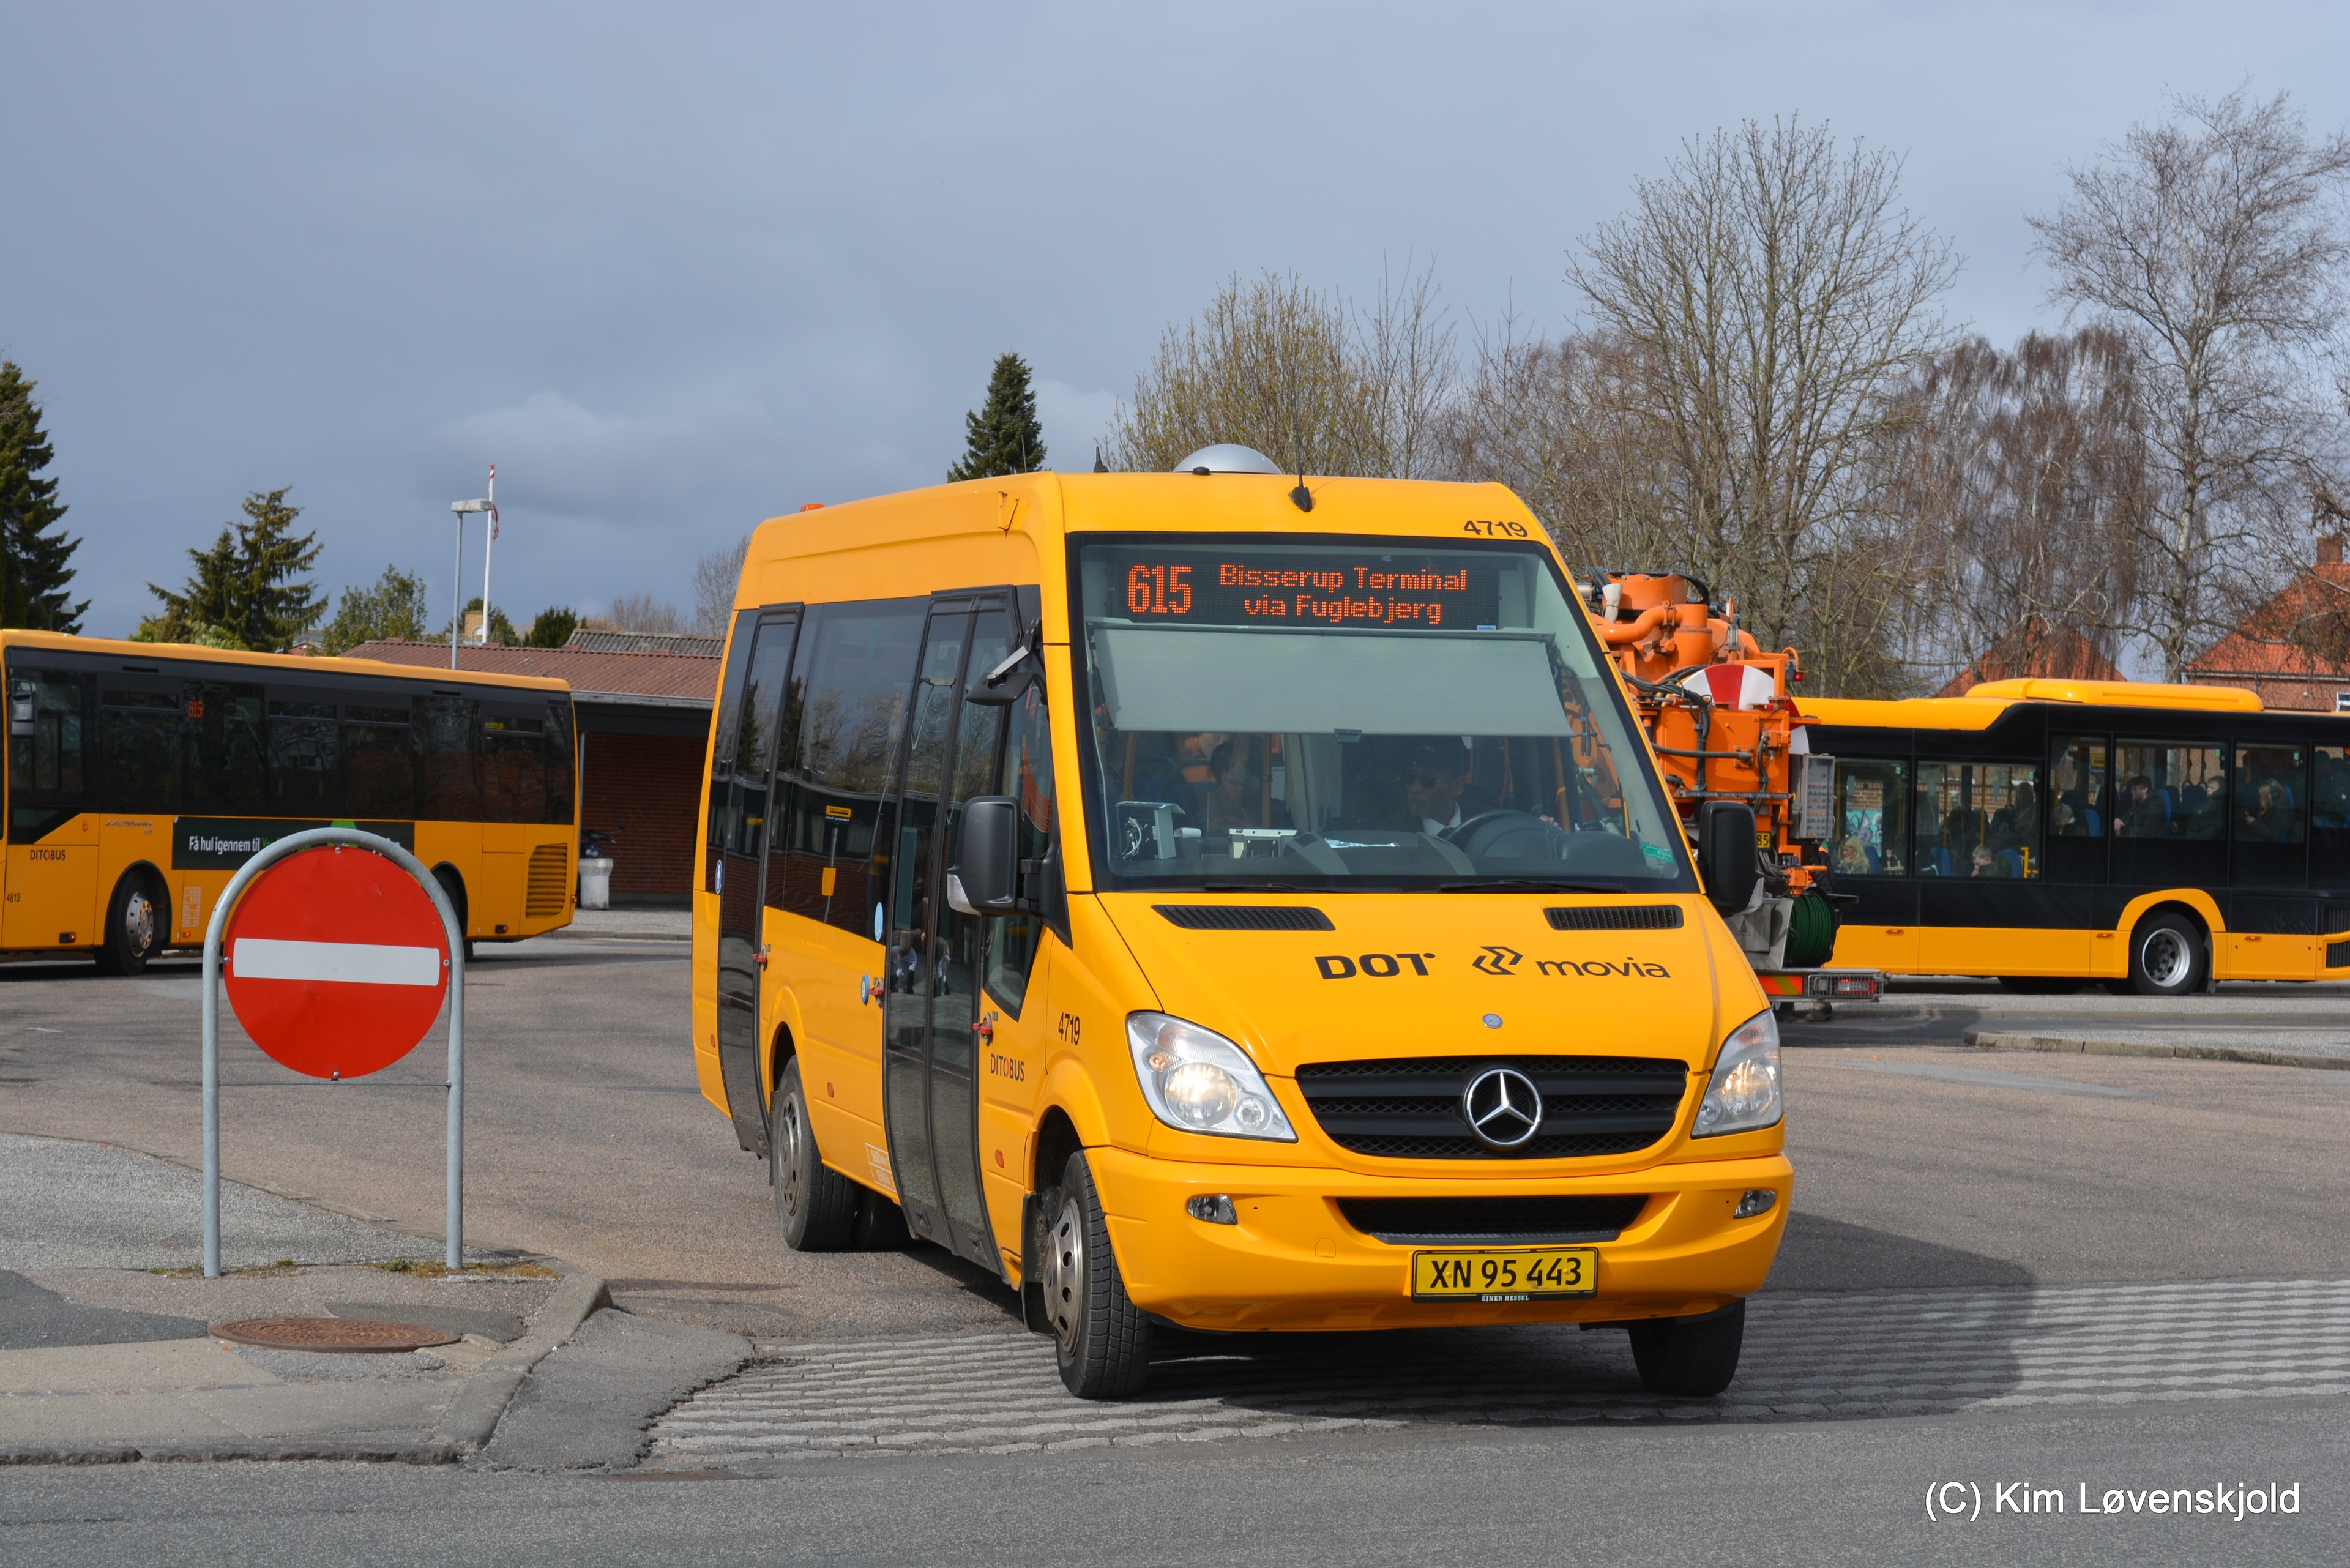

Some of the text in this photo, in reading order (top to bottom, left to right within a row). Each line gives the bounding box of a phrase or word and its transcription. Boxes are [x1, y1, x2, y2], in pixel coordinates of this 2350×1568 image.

[1463, 520, 1528, 537] 4719
[1128, 564, 1192, 614] 615
[1220, 564, 1468, 594] Bisserup Terminal
[1244, 594, 1442, 625] via Fuglebjerg
[29, 849, 66, 861] DITOBUS
[188, 835, 200, 851] Få
[200, 836, 214, 852] hul
[215, 837, 251, 856] igennem
[252, 837, 261, 852] til
[6, 892, 20, 903] 4813
[1314, 952, 1436, 979] DOT
[1535, 957, 1672, 978] movia
[1058, 1012, 1081, 1046] 4719
[990, 1053, 1025, 1083] DITOBUS
[1429, 1256, 1581, 1289] XN 95 443
